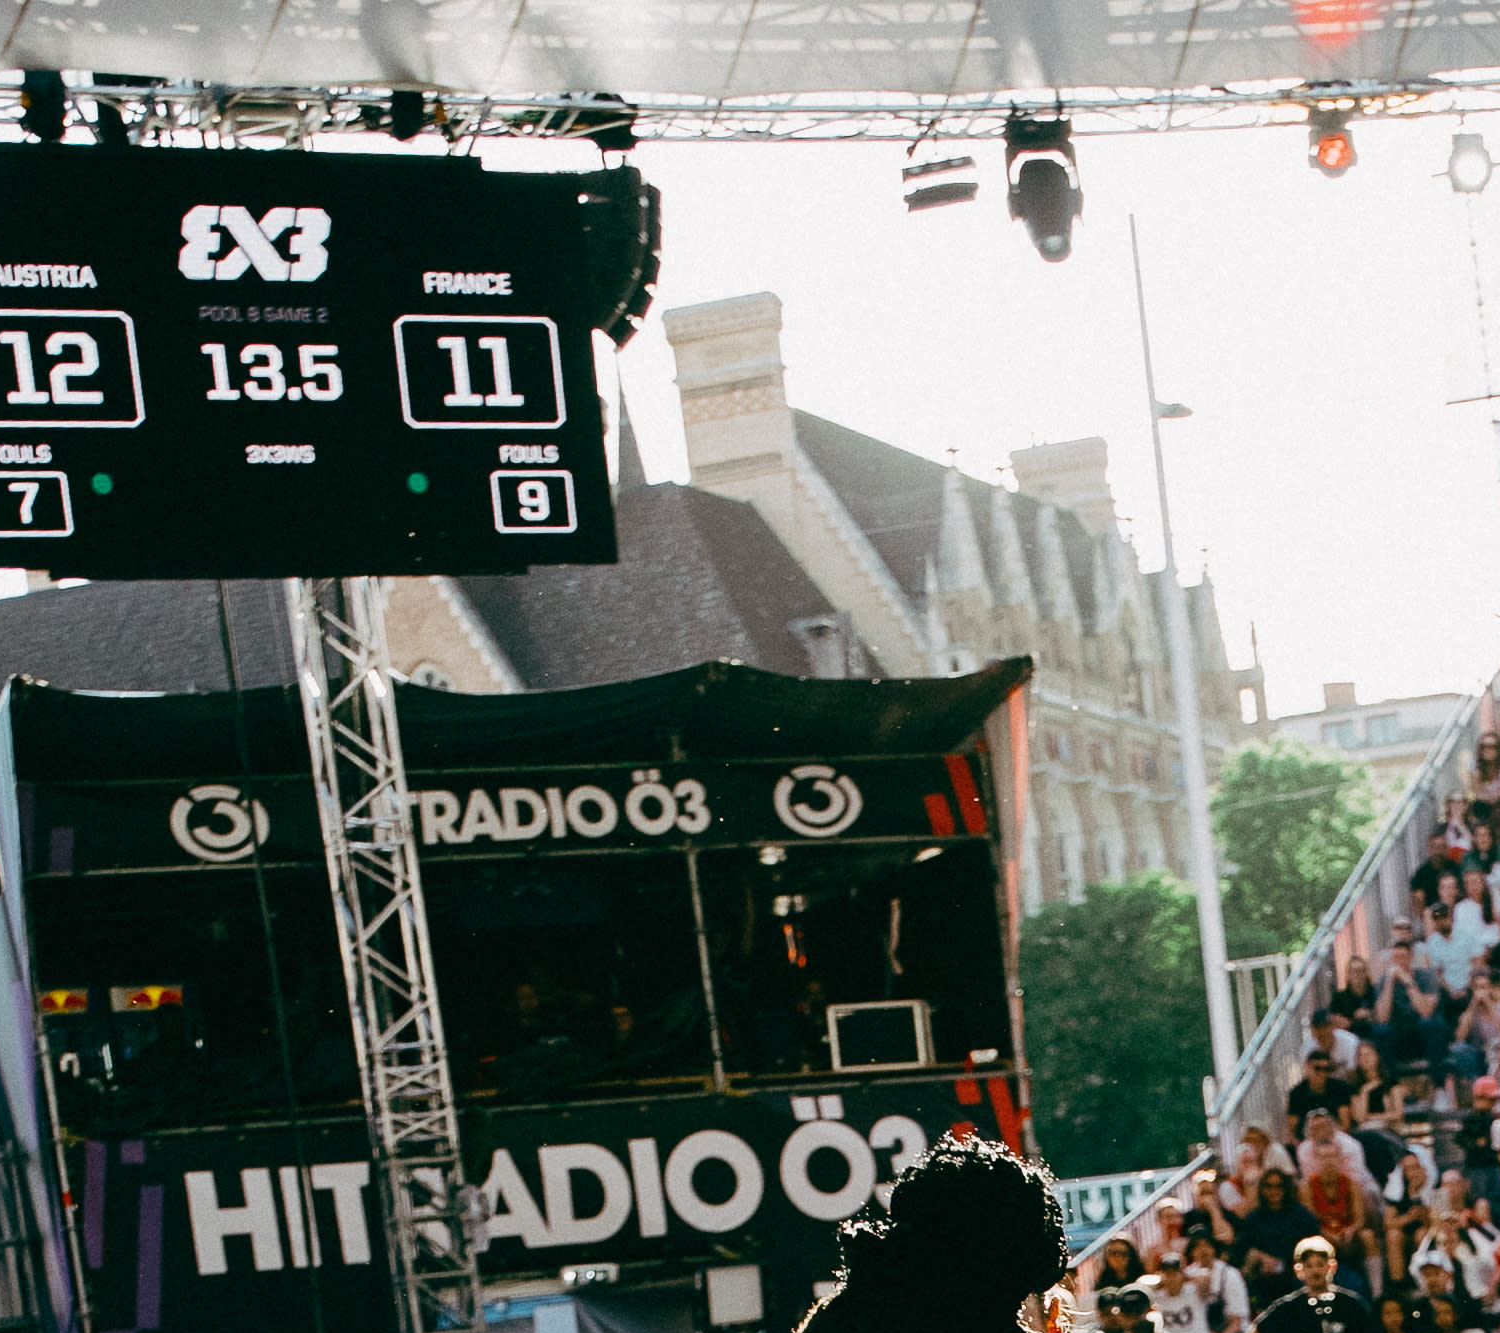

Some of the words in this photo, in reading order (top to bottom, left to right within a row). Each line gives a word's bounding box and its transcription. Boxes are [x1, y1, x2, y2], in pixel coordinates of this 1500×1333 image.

[423, 271, 513, 297] FRANCE
[198, 304, 243, 323] POOL
[264, 305, 313, 324] GAME
[316, 306, 330, 324] 2
[200, 342, 345, 402] 13.5
[435, 334, 525, 408] 11
[500, 443, 560, 466] FOULS
[8, 481, 41, 525] 7
[518, 480, 550, 522] 9
[626, 767, 713, 836] Ö3
